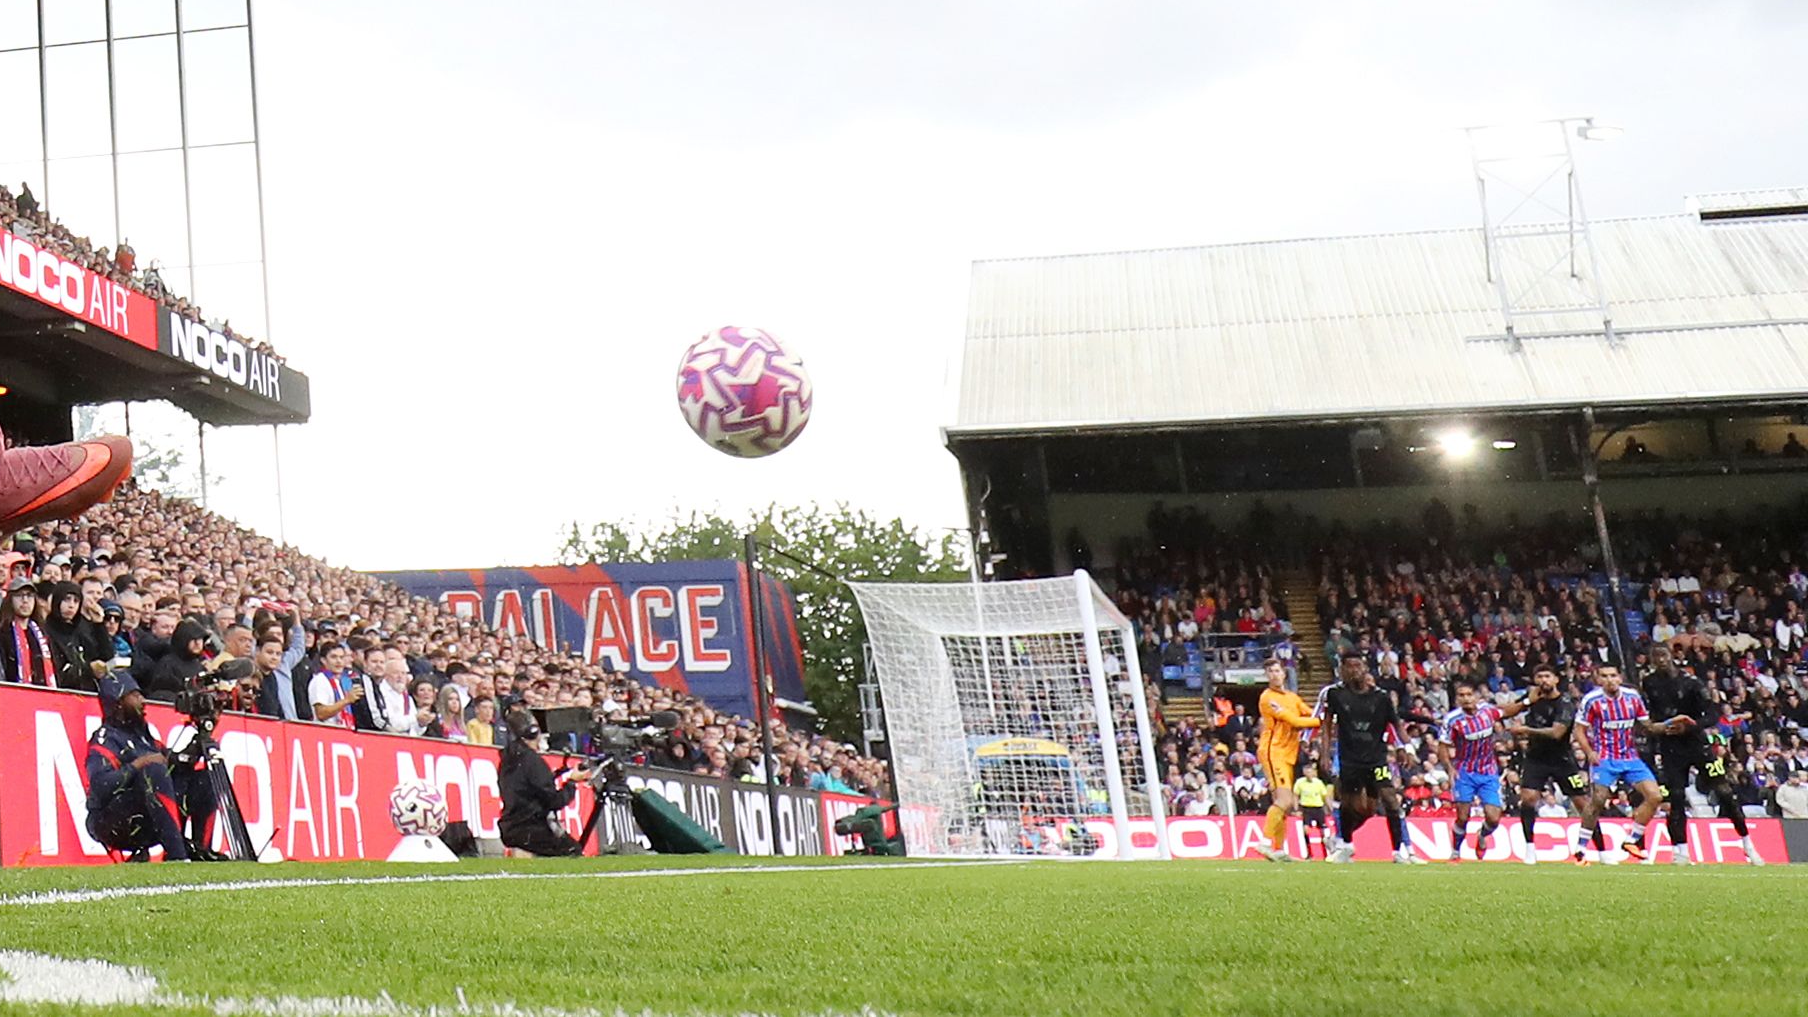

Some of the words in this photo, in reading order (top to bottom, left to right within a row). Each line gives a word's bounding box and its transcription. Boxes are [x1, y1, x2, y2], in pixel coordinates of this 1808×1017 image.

[1374, 766, 1392, 781] 24
[1706, 757, 1725, 777] 20
[1568, 774, 1583, 788] 15
[796, 797, 821, 857] AIR
